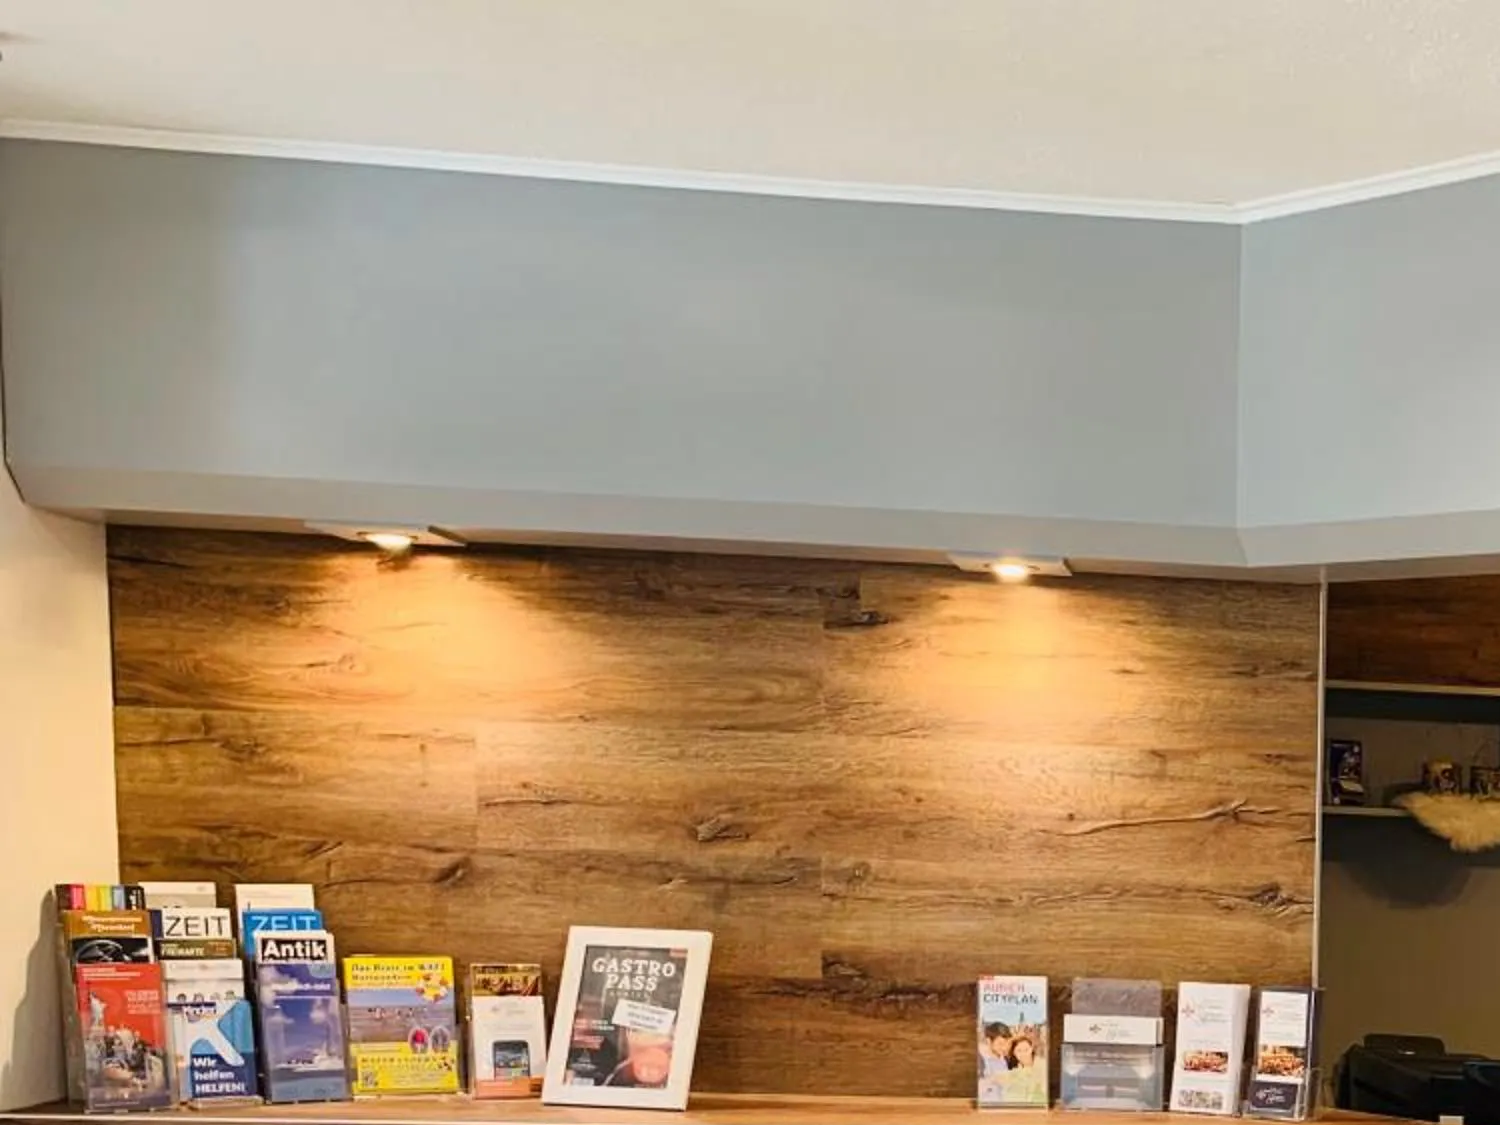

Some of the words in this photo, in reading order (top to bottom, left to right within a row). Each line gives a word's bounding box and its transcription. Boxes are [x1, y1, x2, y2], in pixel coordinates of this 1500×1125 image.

[165, 915, 228, 936] ZEIT
[251, 915, 316, 932] ZEIT
[263, 939, 325, 958] Antik
[592, 957, 676, 977] GASTRO
[606, 973, 657, 992] PASS
[193, 1057, 217, 1067] Wir
[193, 1070, 235, 1081] helfen
